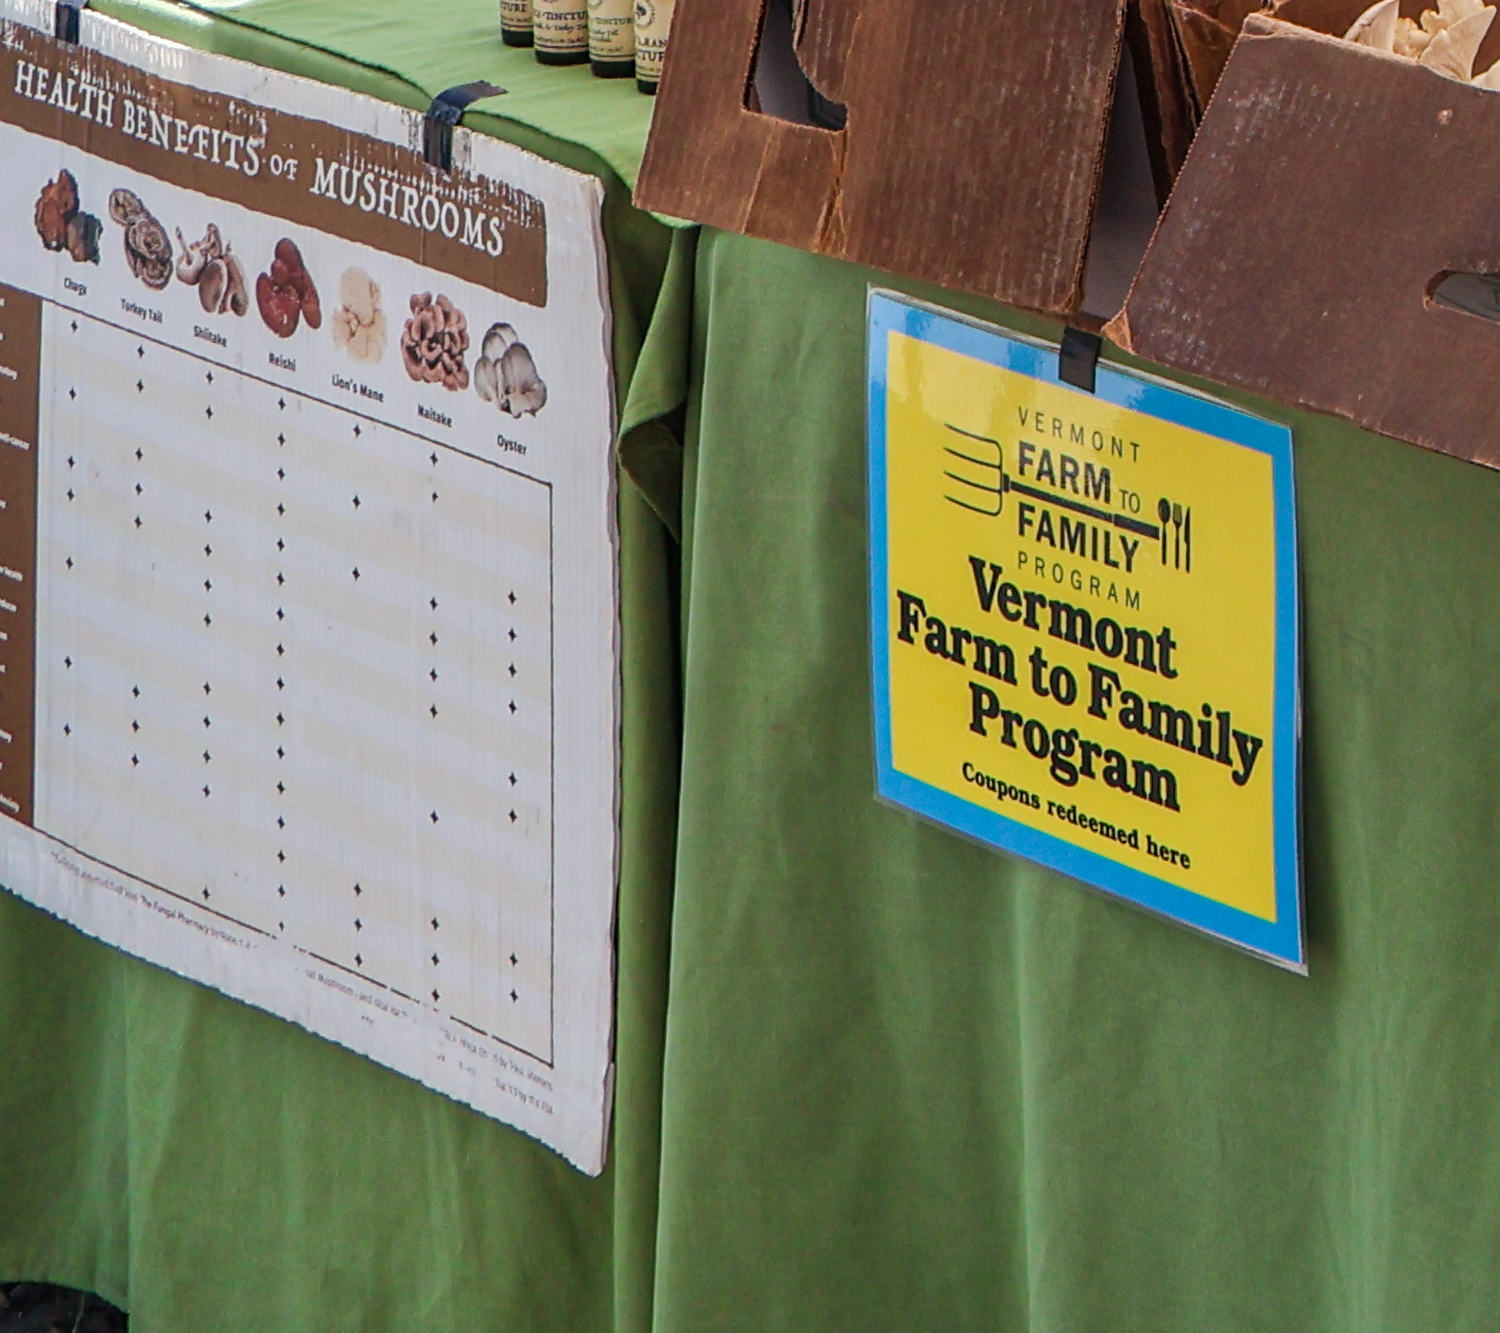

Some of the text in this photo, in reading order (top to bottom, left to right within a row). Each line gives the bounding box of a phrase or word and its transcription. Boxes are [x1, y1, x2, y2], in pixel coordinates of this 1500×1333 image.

[14, 60, 503, 258] HEALTH BENEFITS OF MUSHROOMS
[63, 276, 88, 297] Chaga
[119, 296, 163, 324] Turkey Tail
[192, 324, 228, 349] Shiitake
[268, 351, 296, 373] Reishi
[331, 373, 385, 404] Lion's Mane
[416, 403, 453, 429] Maitake
[496, 433, 528, 457] Oyster
[1017, 406, 1141, 463] VERMONT
[1017, 442, 1141, 514] FARM TO
[1017, 503, 1141, 574] FAMILY
[1017, 550, 1141, 611] PROGRAM
[968, 556, 1178, 678] Vermont
[896, 590, 1263, 786] Farm to Family
[968, 681, 1180, 811] Program
[962, 762, 1191, 870] Coupons redeemed here
